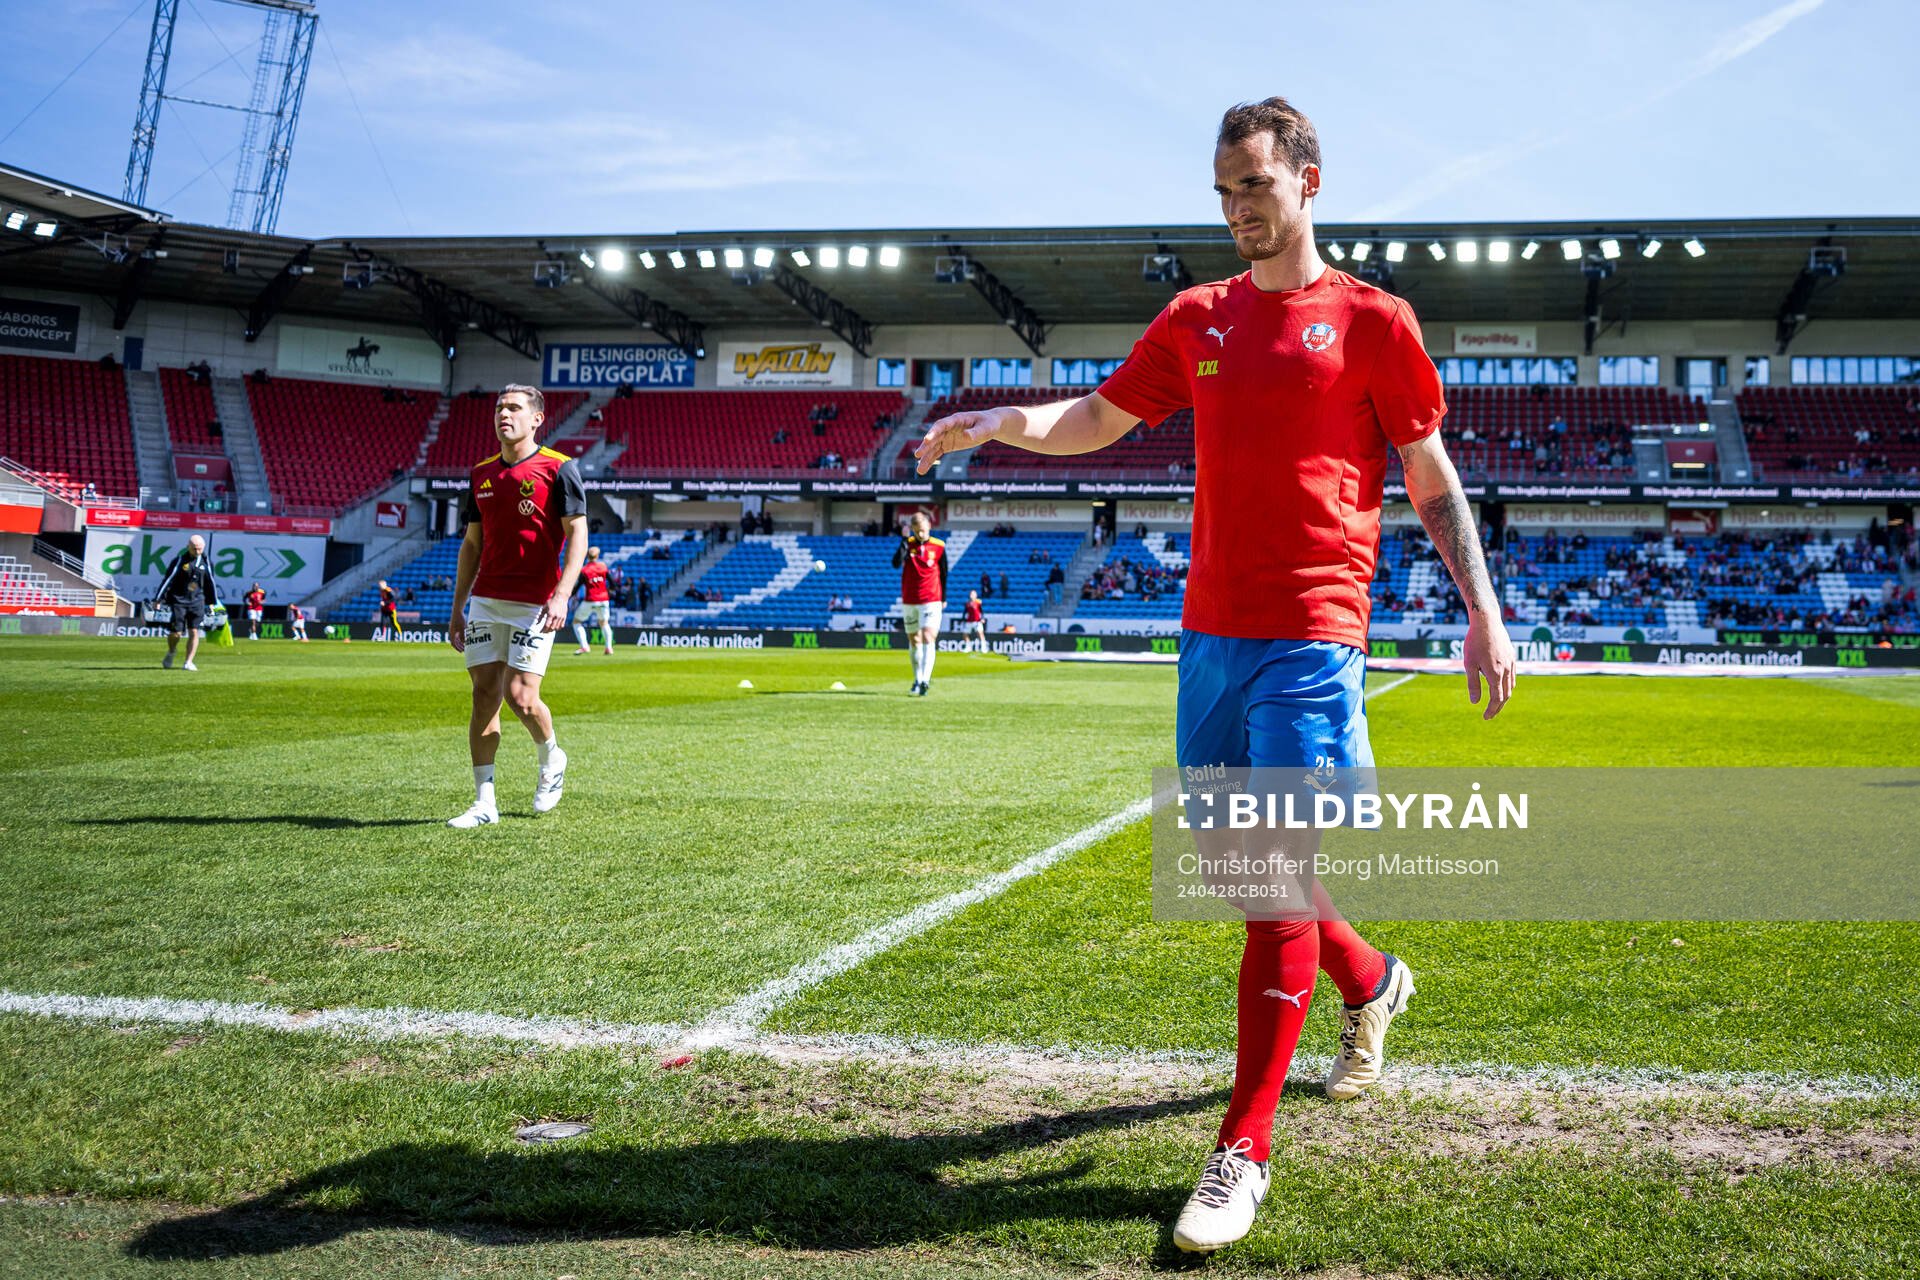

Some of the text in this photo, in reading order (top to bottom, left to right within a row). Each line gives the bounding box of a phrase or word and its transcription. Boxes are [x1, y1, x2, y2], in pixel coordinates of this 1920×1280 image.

[580, 361, 687, 383] BYGGPLÅT
[1197, 360, 1219, 377] XXL
[953, 503, 983, 518] Det
[1514, 507, 1543, 522] Det
[101, 535, 244, 578] aka
[98, 622, 114, 637] All
[116, 623, 170, 638] sports
[261, 624, 284, 638] XXL
[637, 631, 764, 648] All sports united
[793, 633, 819, 648] XXL
[865, 634, 890, 649] XXL
[994, 637, 1045, 654] united
[1076, 637, 1102, 652] XXL
[1151, 638, 1178, 654] XXL
[1371, 641, 1399, 657] XXL
[1603, 645, 1632, 662] XXL
[1657, 648, 1803, 666] All sports united
[1837, 650, 1867, 666] XXL
[1186, 762, 1226, 782] Solid
[1314, 756, 1336, 777] 25
[1188, 780, 1243, 796] Försäkring
